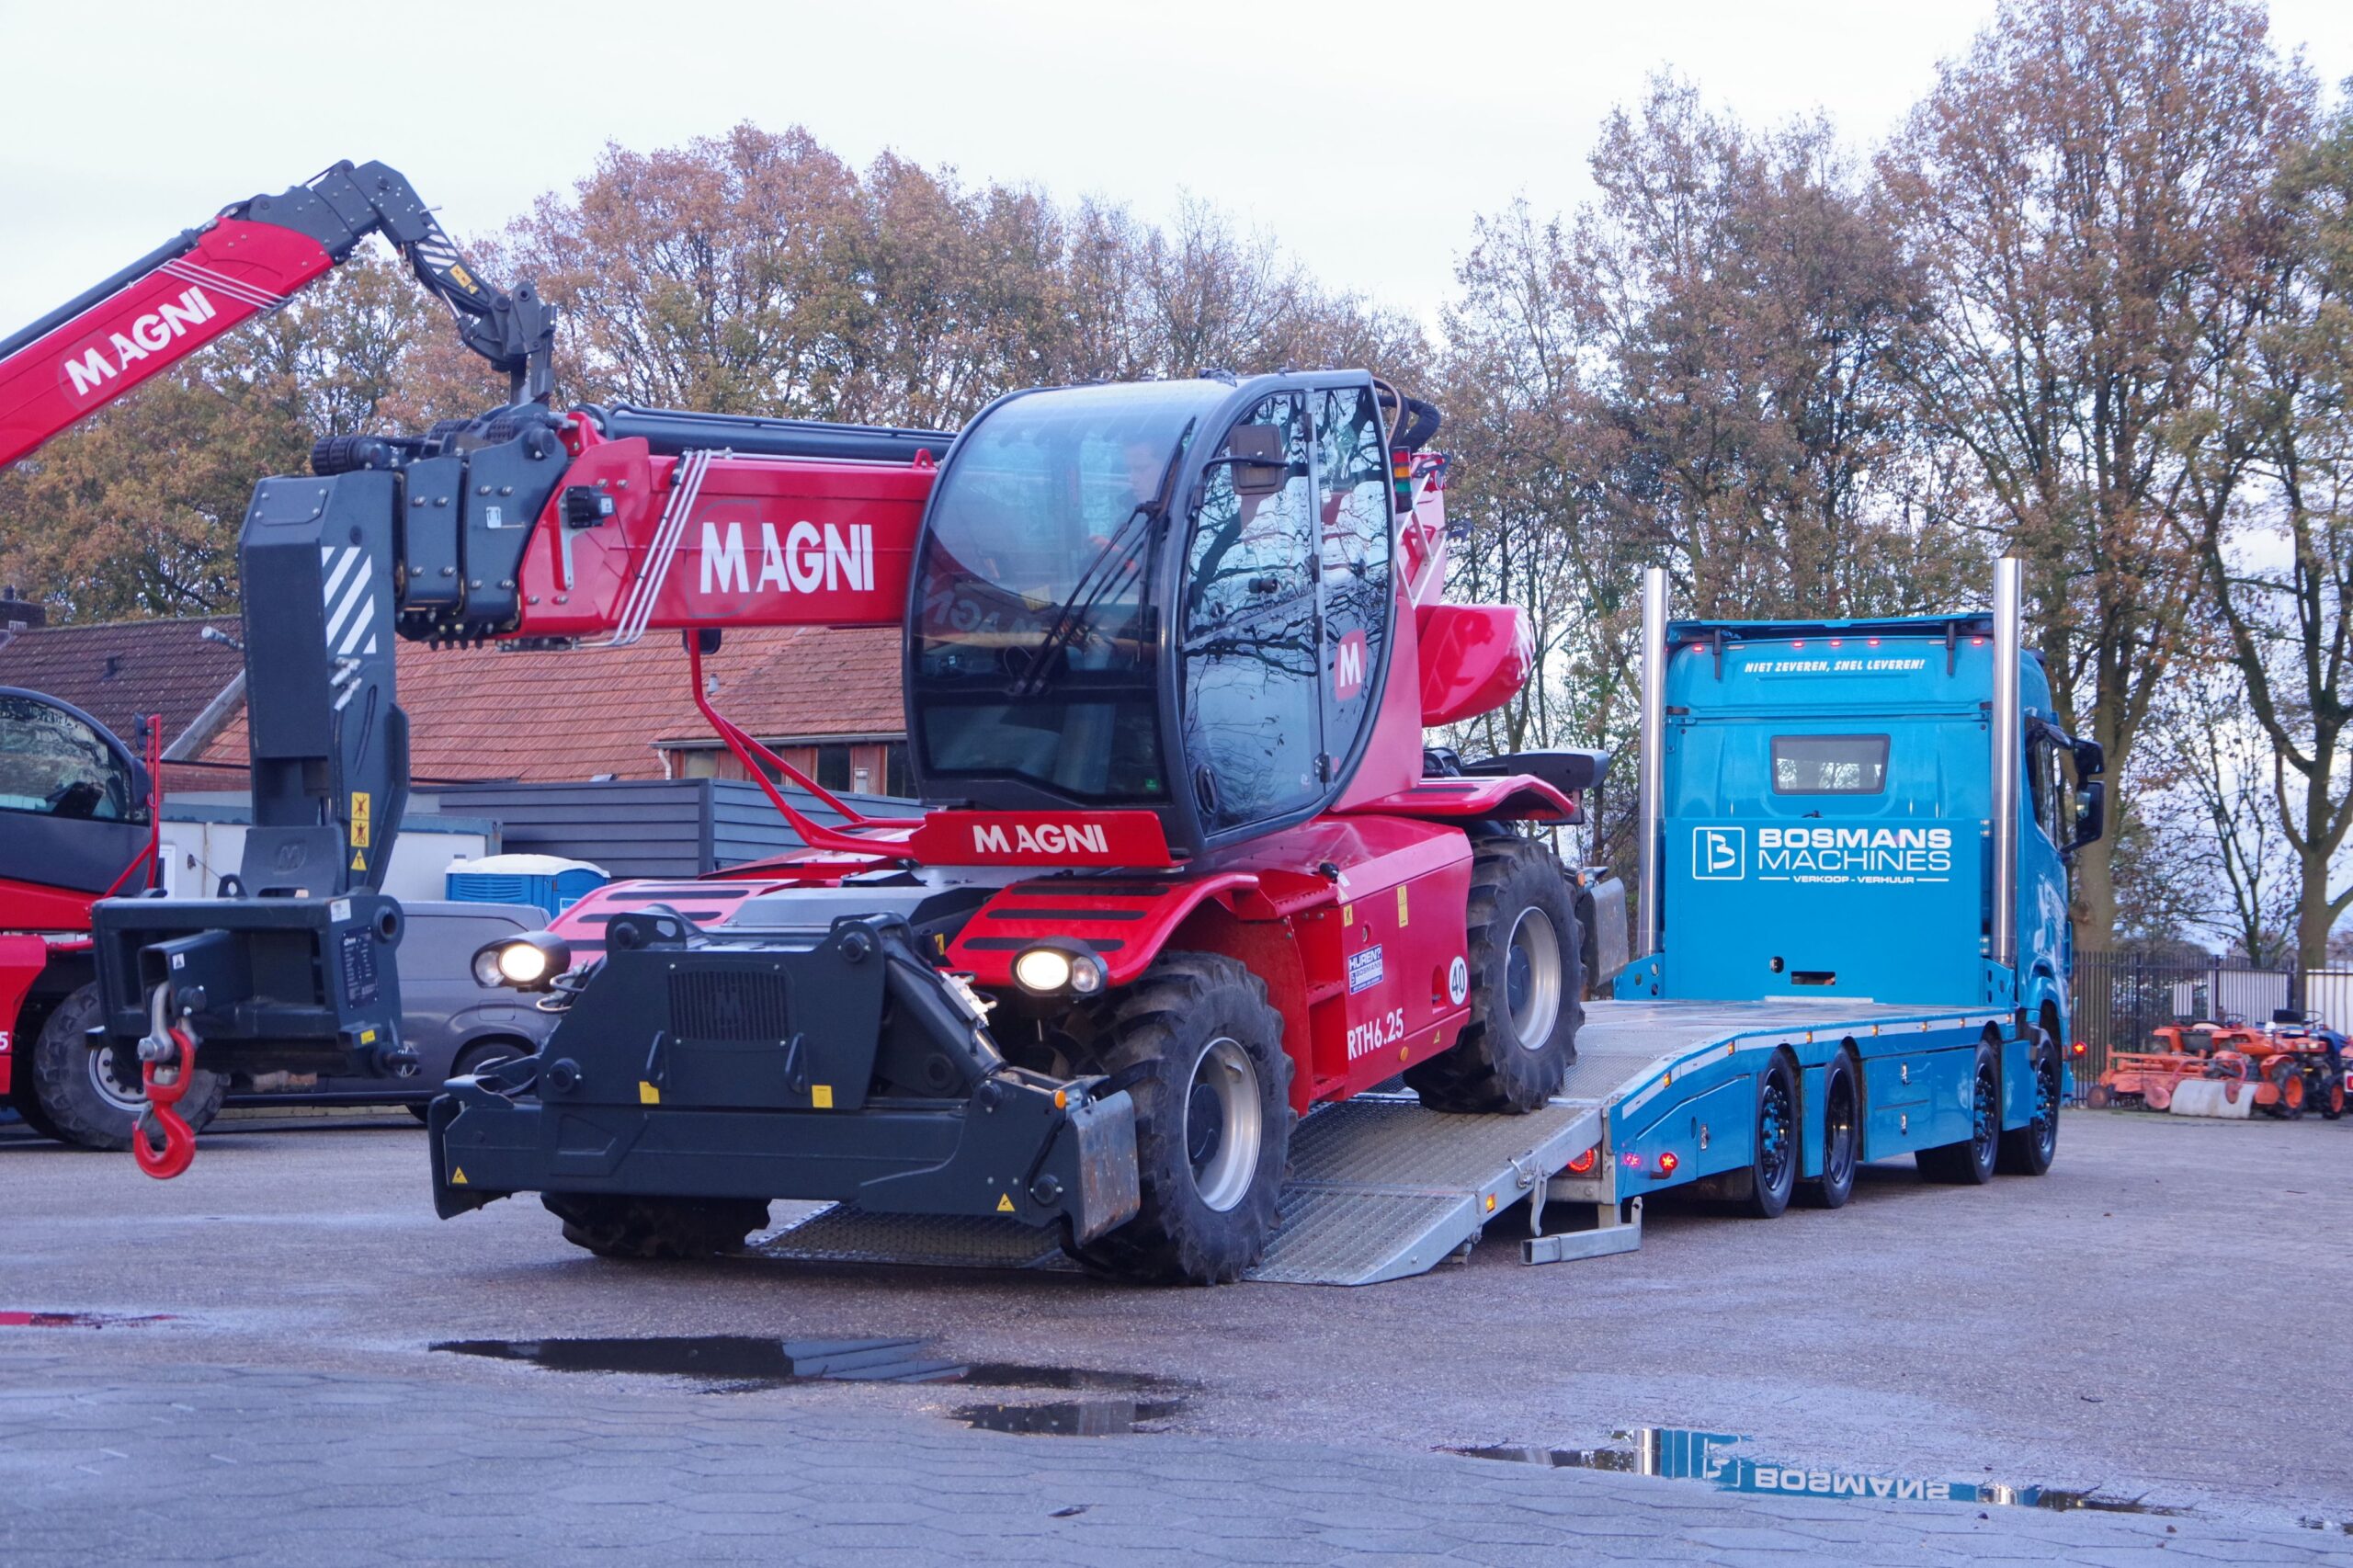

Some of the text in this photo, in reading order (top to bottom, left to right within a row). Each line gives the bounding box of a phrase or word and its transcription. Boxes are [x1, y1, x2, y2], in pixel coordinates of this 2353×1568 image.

[64, 286, 217, 396] MAGNI
[700, 520, 874, 594] MAGNI
[1340, 642, 1361, 687] M
[1745, 659, 1926, 673] NIET ZEVEREN, SNEL LEVEREN!
[972, 824, 1108, 853] MAGNI
[1759, 828, 1951, 849] BOSMANS
[1758, 850, 1951, 871] MACHINES
[1793, 875, 1849, 883] VERKOOP
[1858, 876, 1914, 884] VERHUUR
[1349, 947, 1381, 971] HUREN?
[1451, 963, 1466, 996] 40
